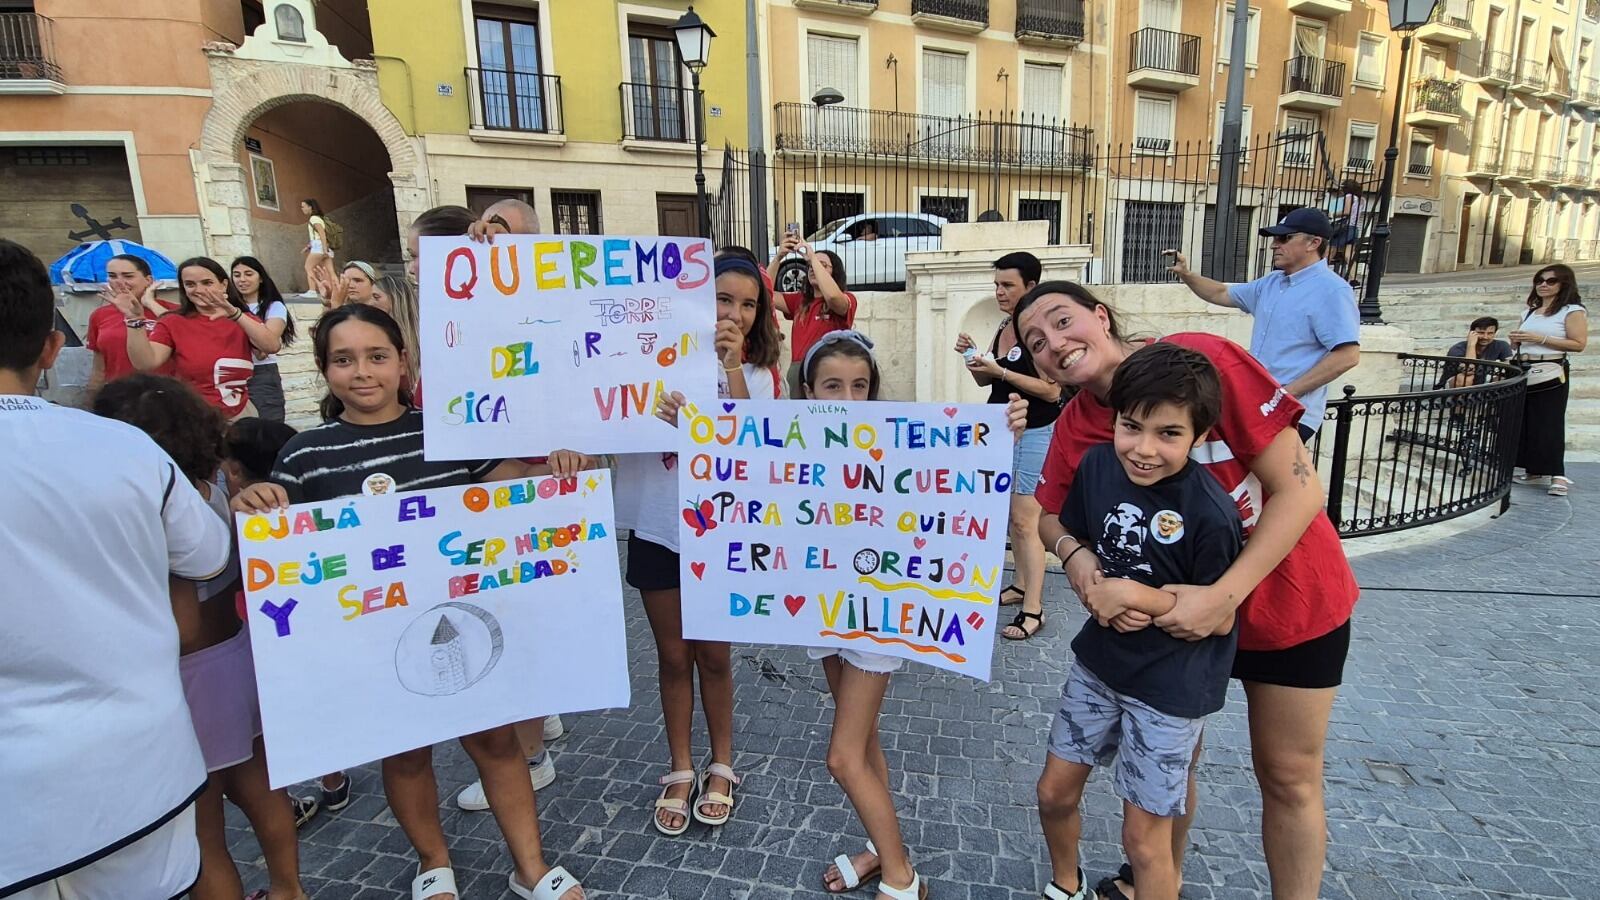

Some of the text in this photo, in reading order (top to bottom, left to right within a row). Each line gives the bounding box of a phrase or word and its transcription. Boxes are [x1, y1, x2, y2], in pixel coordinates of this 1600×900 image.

[444, 239, 710, 300] QUEREMOS
[590, 297, 672, 326] TORRE
[491, 341, 539, 379] DEL
[442, 391, 510, 425] SIGA
[807, 404, 849, 416] VILLENA
[824, 422, 877, 450] NO
[886, 417, 990, 449] TENER
[690, 453, 1012, 494] QUE LEER UN CUENTO
[243, 501, 361, 541] OJALÁ
[398, 495, 437, 523] EL
[711, 491, 989, 541] PARA SABER QUIÉN
[247, 551, 347, 592] DEJE
[371, 544, 407, 571] DE
[438, 531, 507, 567] SER
[727, 542, 788, 573] ERA
[805, 546, 838, 570] EL
[259, 598, 299, 637] Y
[338, 581, 409, 621] SEA
[730, 592, 776, 617] DE
